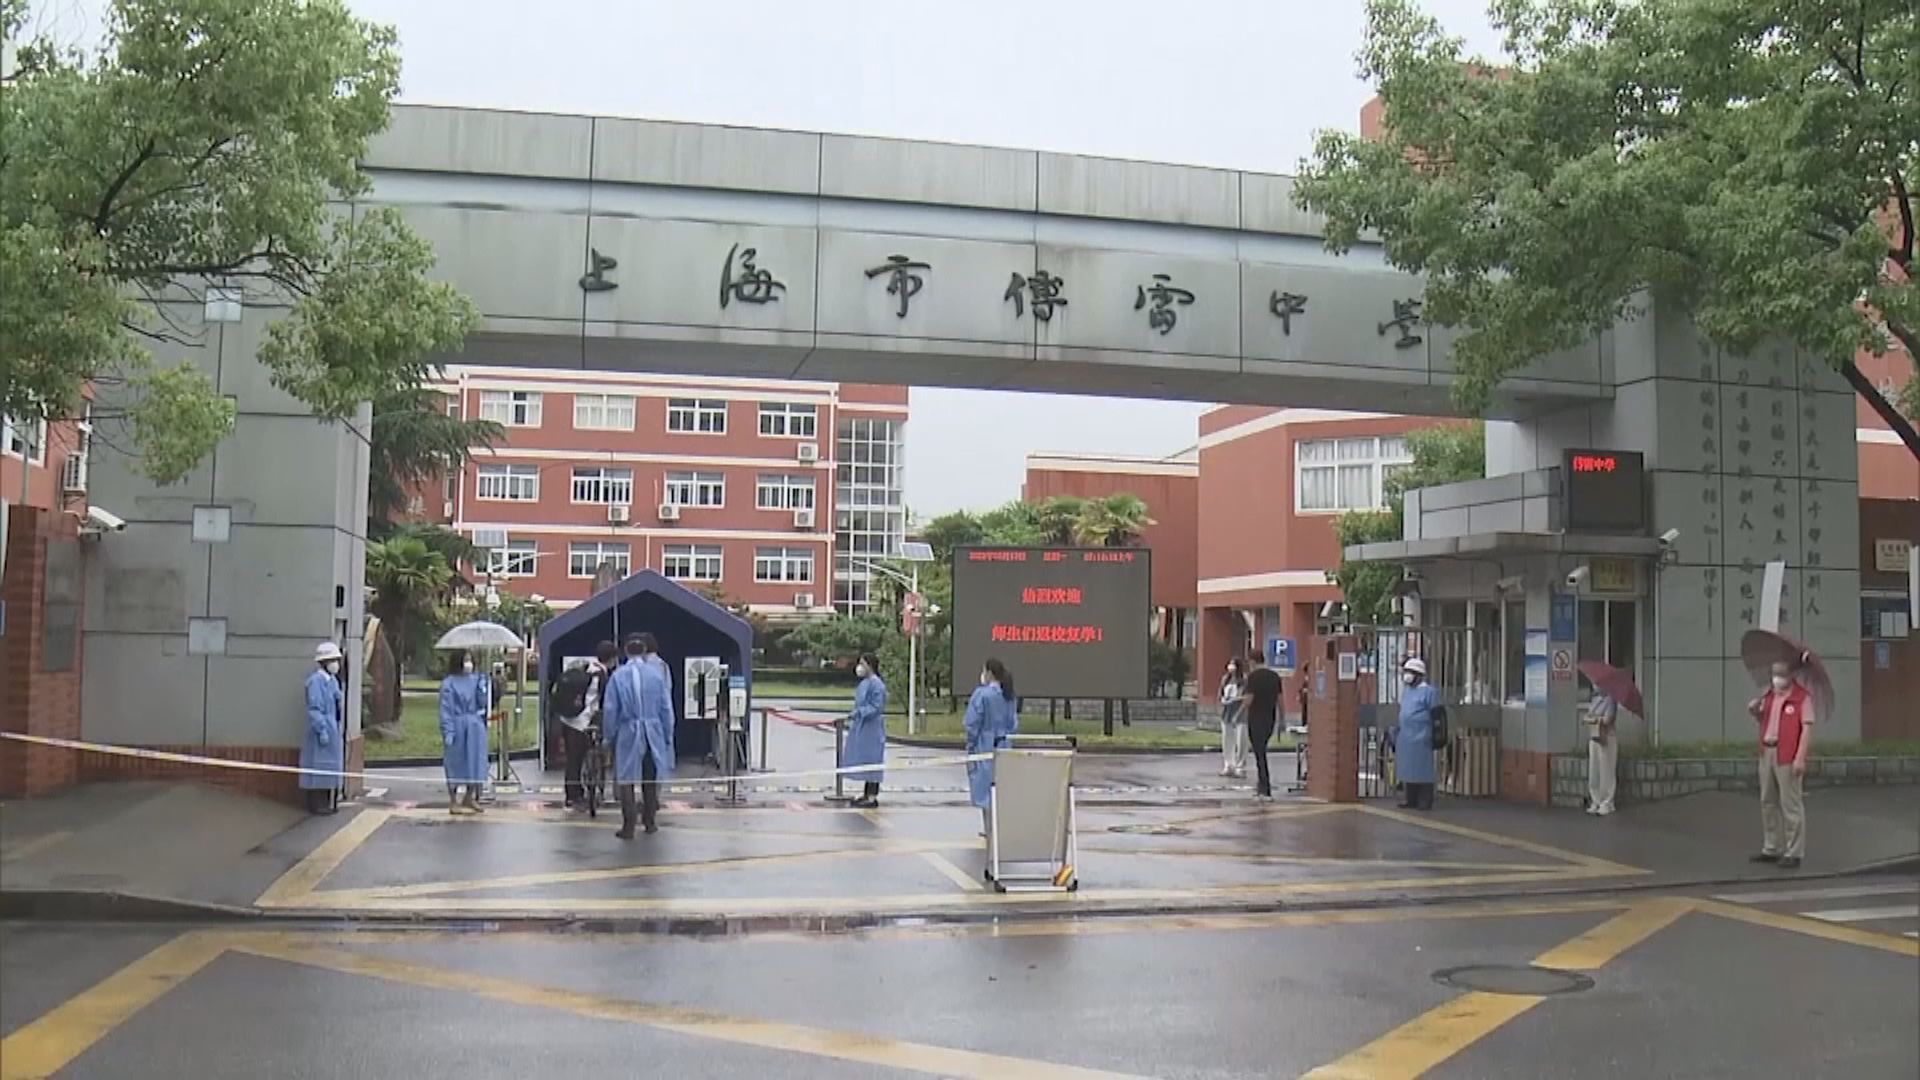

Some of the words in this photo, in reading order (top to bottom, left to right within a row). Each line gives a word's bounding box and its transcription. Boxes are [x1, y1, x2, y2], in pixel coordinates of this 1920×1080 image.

[1022, 587, 1081, 605] 热烈欢迎
[1276, 640, 1288, 655] P
